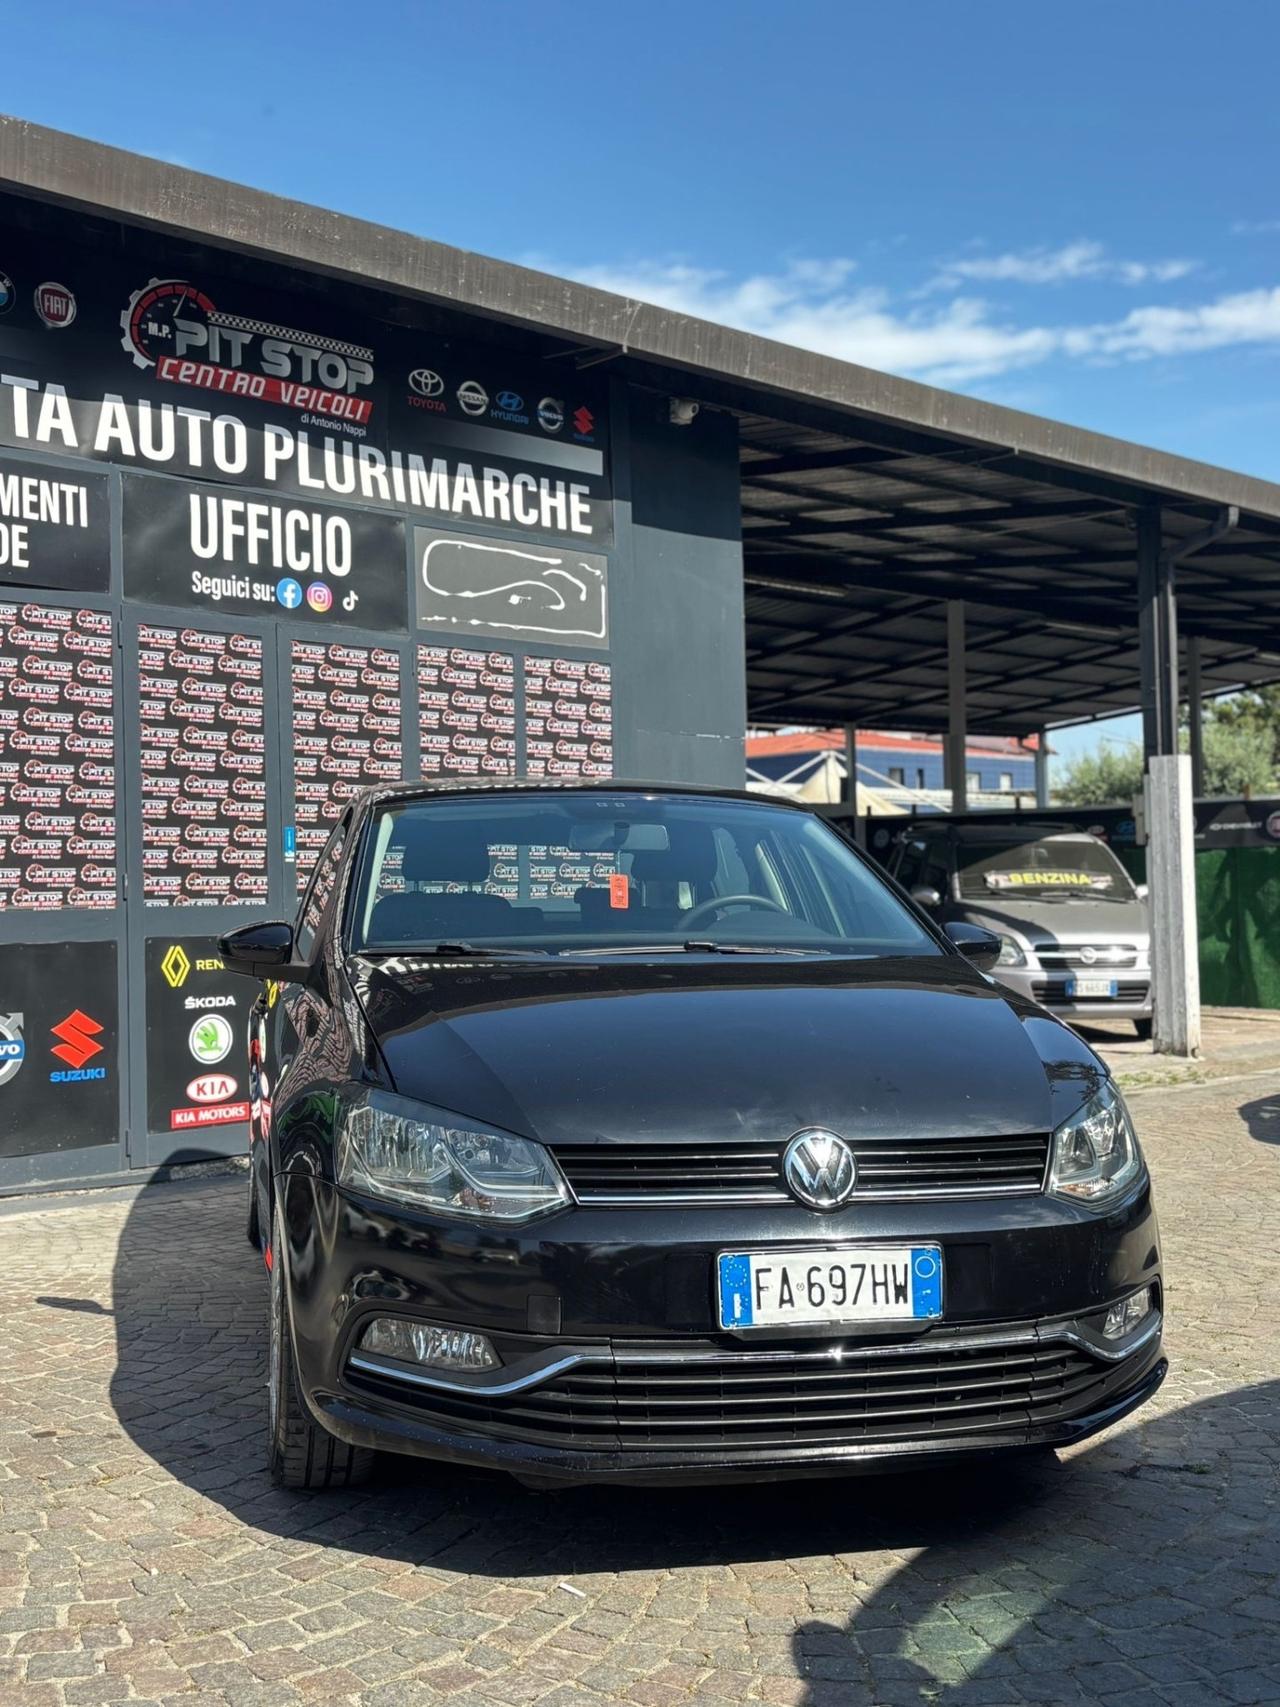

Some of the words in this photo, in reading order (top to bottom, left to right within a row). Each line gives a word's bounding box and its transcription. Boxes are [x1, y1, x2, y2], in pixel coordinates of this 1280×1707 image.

[44, 294, 68, 317] FIAT
[147, 321, 172, 339] M.P.
[174, 318, 253, 368] PIT
[260, 338, 374, 394] STOP
[407, 396, 447, 413] TOYOTA
[300, 414, 308, 423] di
[309, 415, 341, 432] Antonio
[342, 421, 367, 437] Nappi
[1, 374, 79, 448] TA
[94, 393, 248, 474] AUTO
[264, 424, 593, 534] PLURIMARCHE
[189, 493, 352, 577] UFFICIO
[192, 571, 250, 600] Seguici
[252, 582, 276, 602] su:
[1010, 873, 1092, 885] BENZINA
[185, 996, 236, 1009] ŠKODA
[50, 1068, 105, 1082] SUZUKI
[196, 1081, 230, 1096] KIA
[175, 1111, 195, 1124] KIA
[199, 1106, 245, 1120] MOTORS
[755, 1266, 796, 1311] FA
[807, 1263, 909, 1308] 697HW
